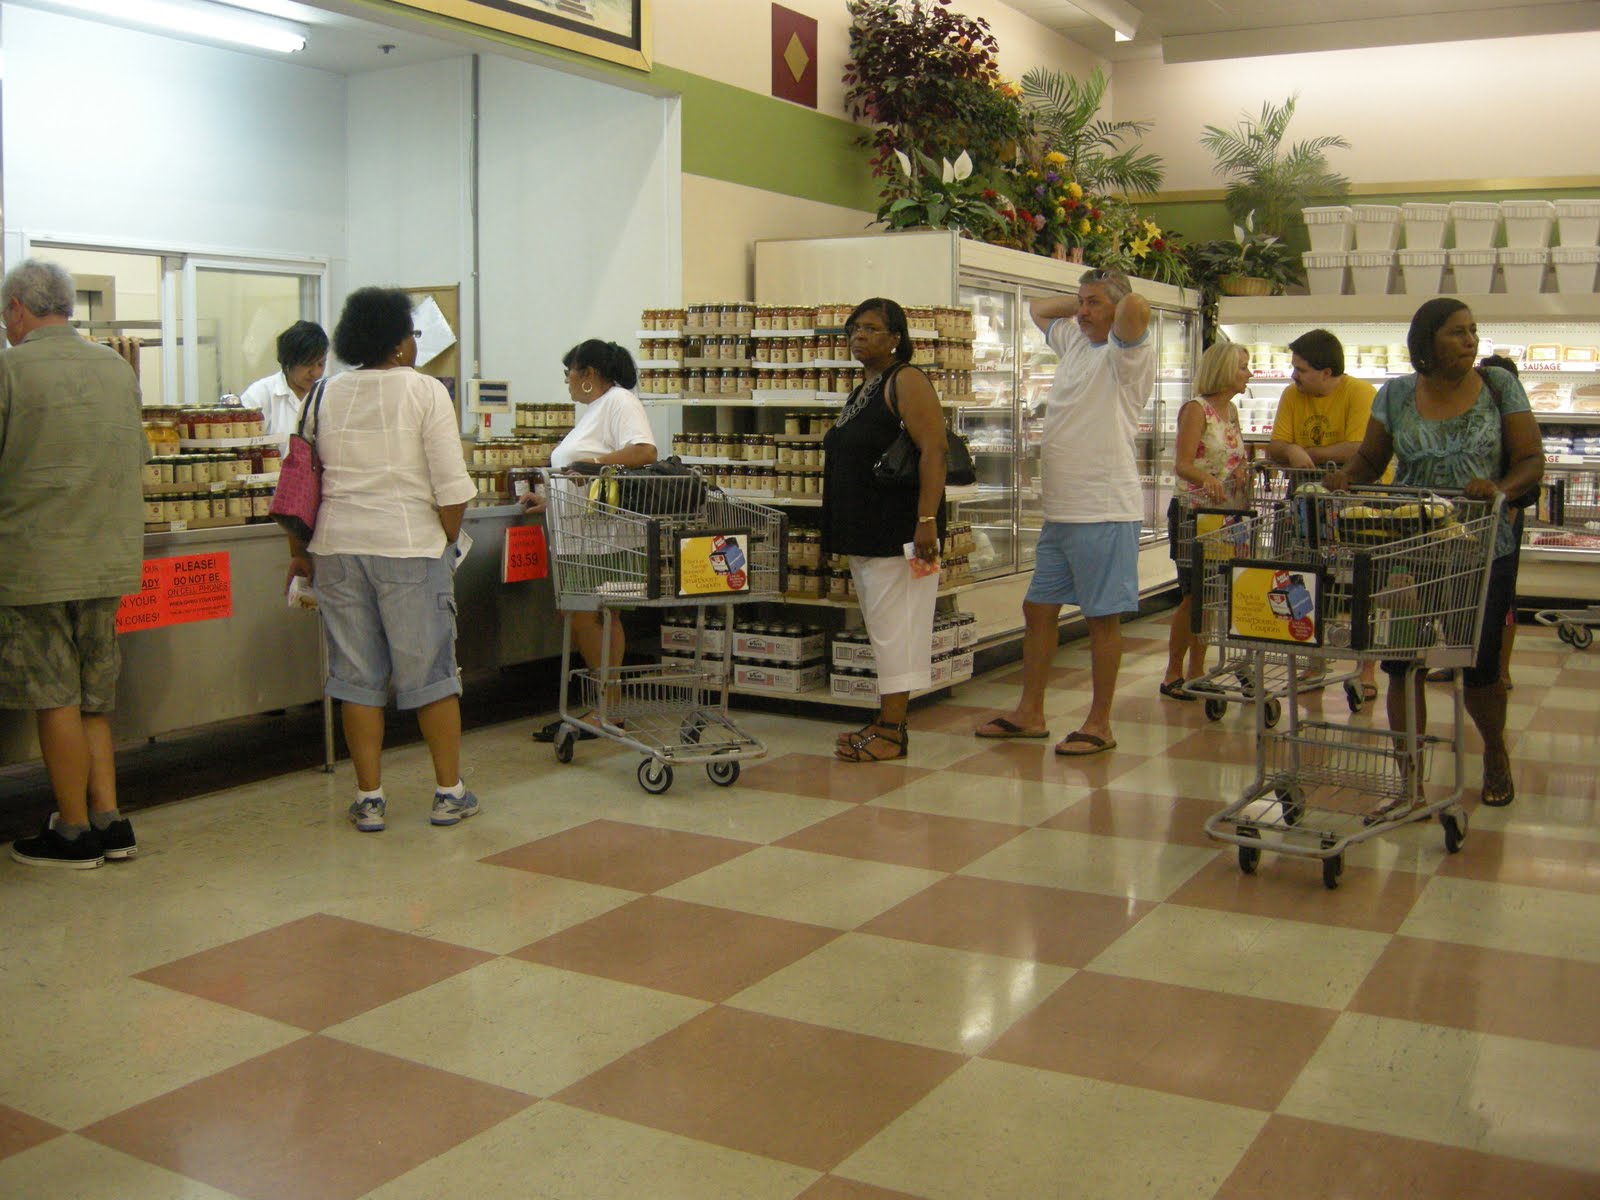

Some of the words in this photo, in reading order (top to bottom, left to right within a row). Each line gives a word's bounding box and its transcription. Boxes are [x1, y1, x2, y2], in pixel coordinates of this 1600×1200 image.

[1523, 363, 1561, 371] SAUSAGE
[174, 560, 216, 572] PLEASE!
[511, 553, 538, 568] $3.59
[173, 577, 187, 586] DO
[188, 574, 207, 584] NOT
[209, 572, 220, 581] BE
[167, 588, 178, 596] ON
[180, 585, 197, 595] CELL
[129, 595, 157, 607] YOUR
[125, 612, 160, 624] COMES!
